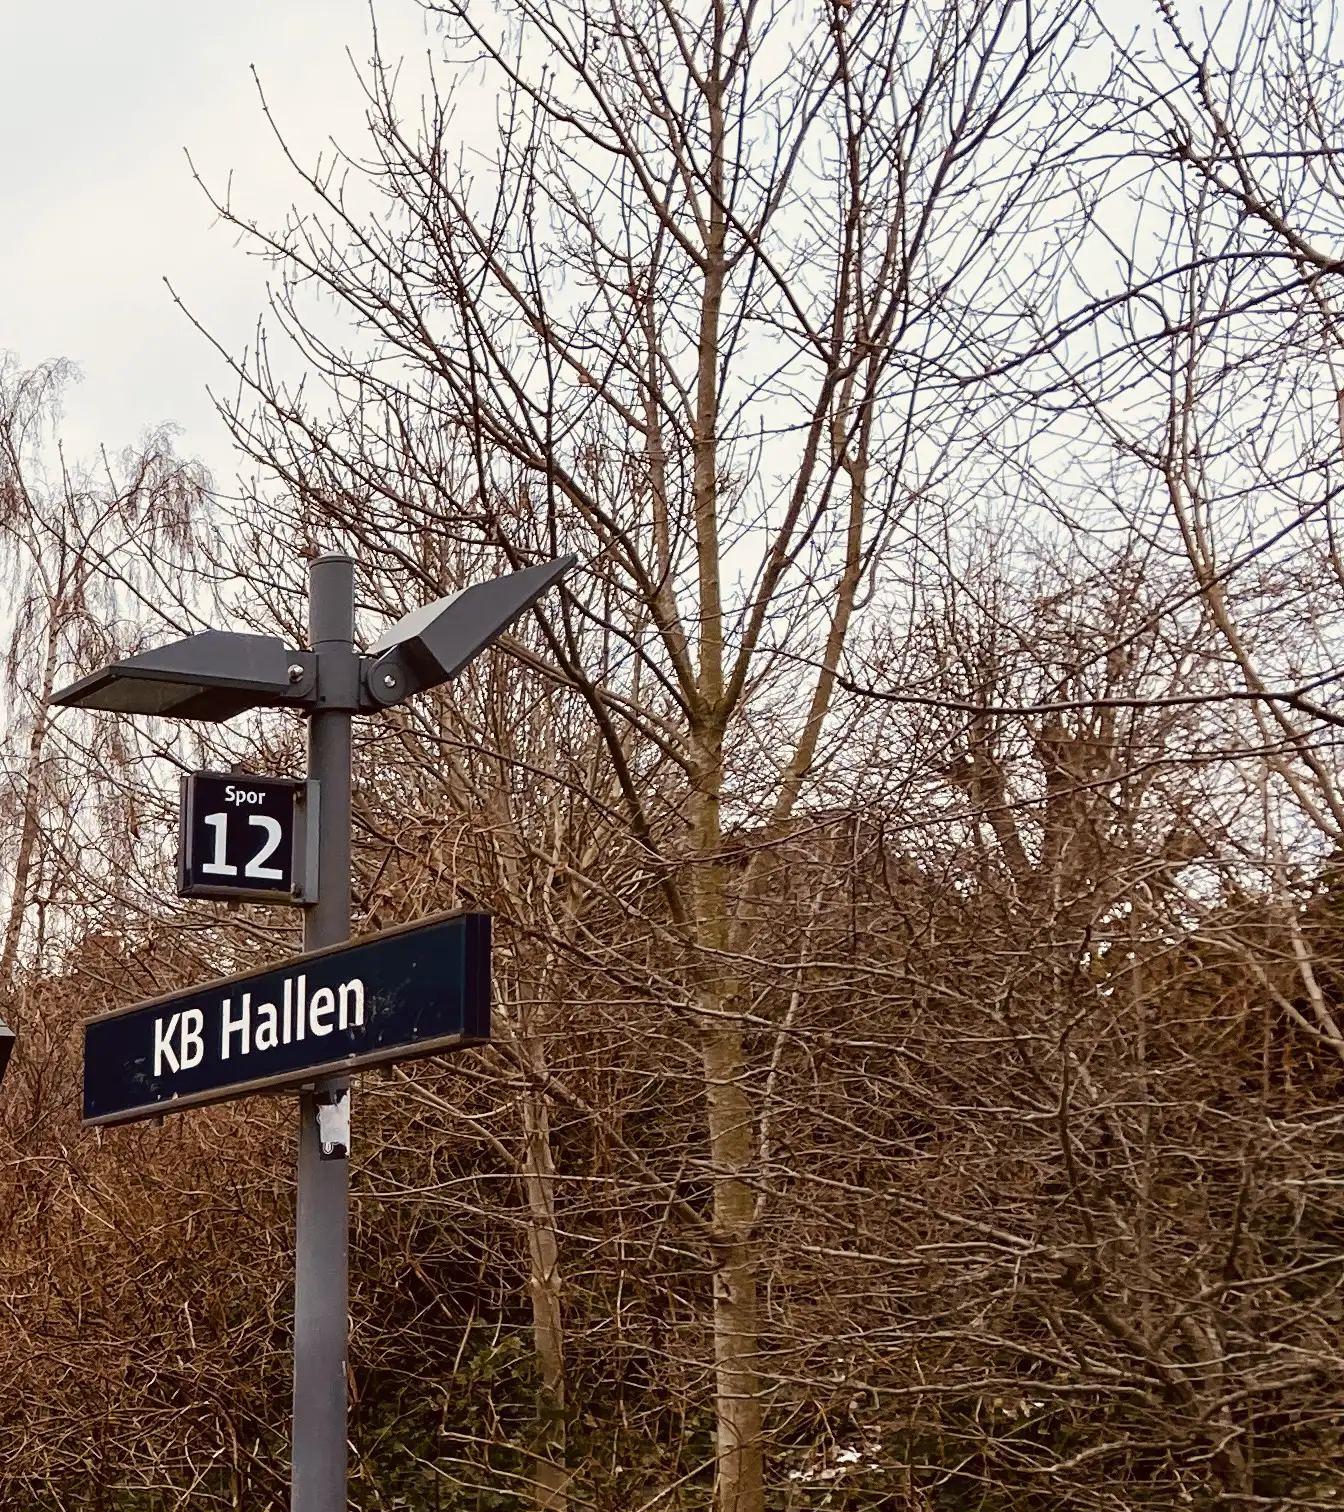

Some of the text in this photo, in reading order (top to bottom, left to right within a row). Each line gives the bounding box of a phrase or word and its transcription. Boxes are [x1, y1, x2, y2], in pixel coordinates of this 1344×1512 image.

[224, 785, 267, 806] Spor
[201, 812, 284, 881] 12
[153, 974, 366, 1077] KB Hallen
